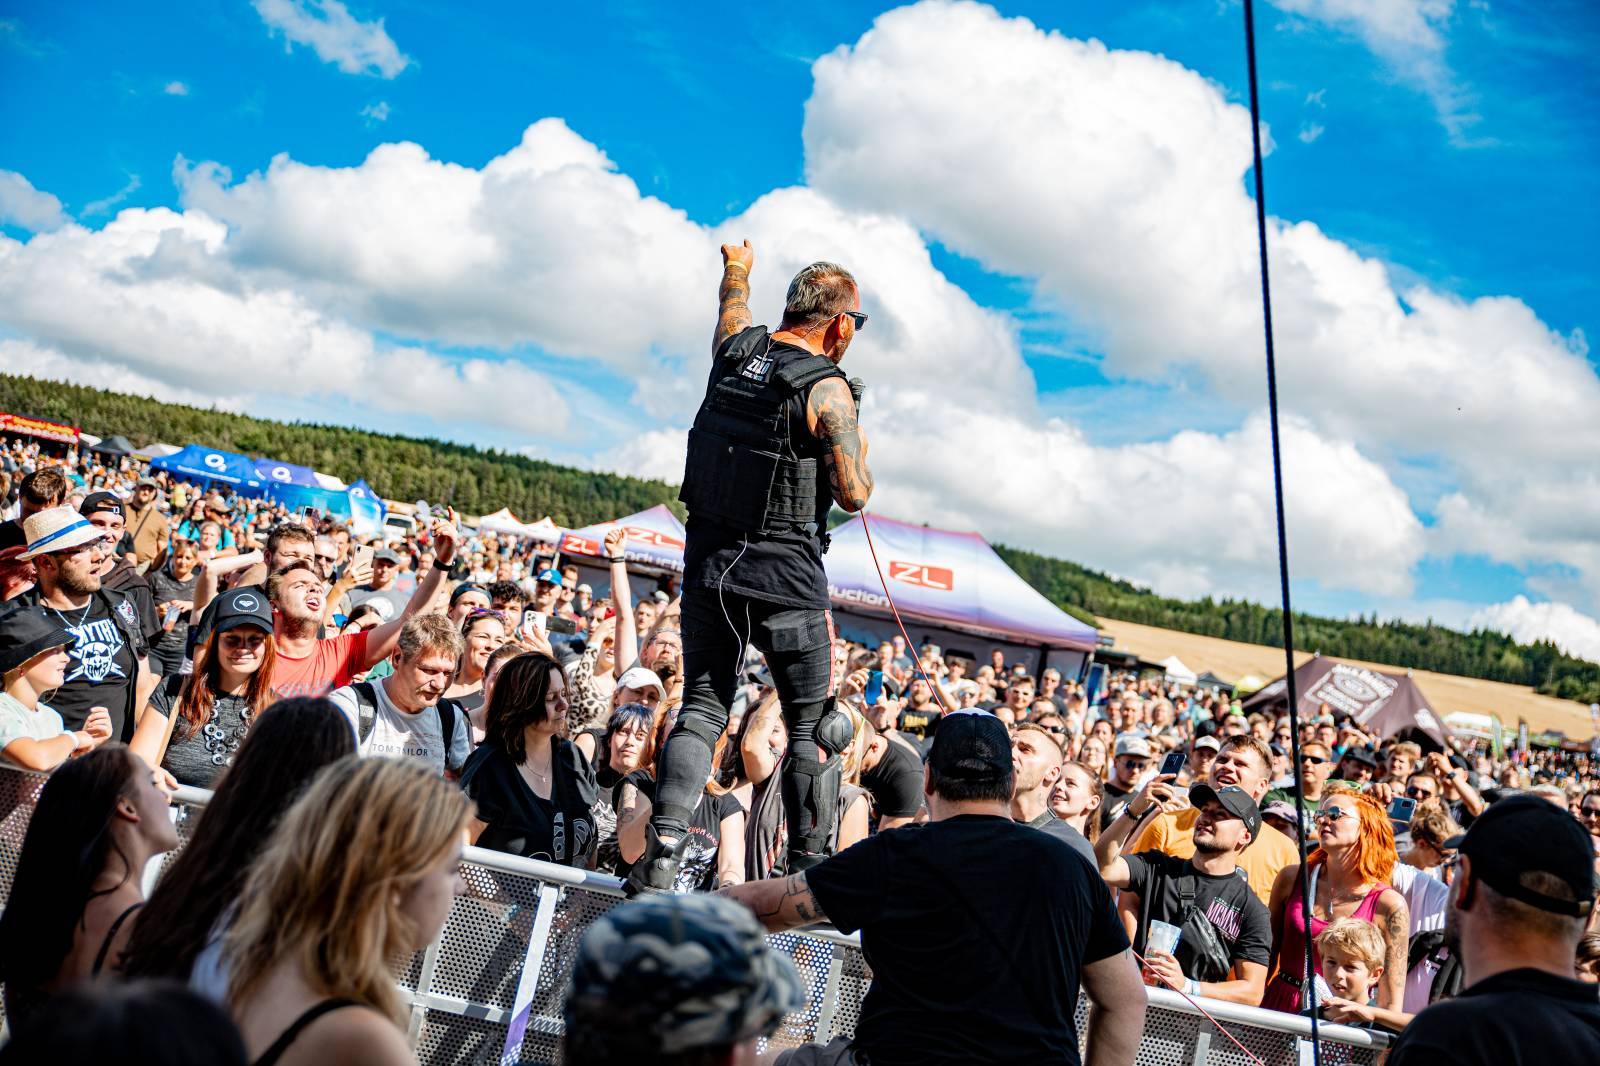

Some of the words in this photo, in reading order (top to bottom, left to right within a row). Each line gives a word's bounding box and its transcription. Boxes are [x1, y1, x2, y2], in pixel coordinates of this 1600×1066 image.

[564, 536, 595, 556] ZL
[894, 563, 948, 589] ZL
[372, 743, 394, 753] TOM
